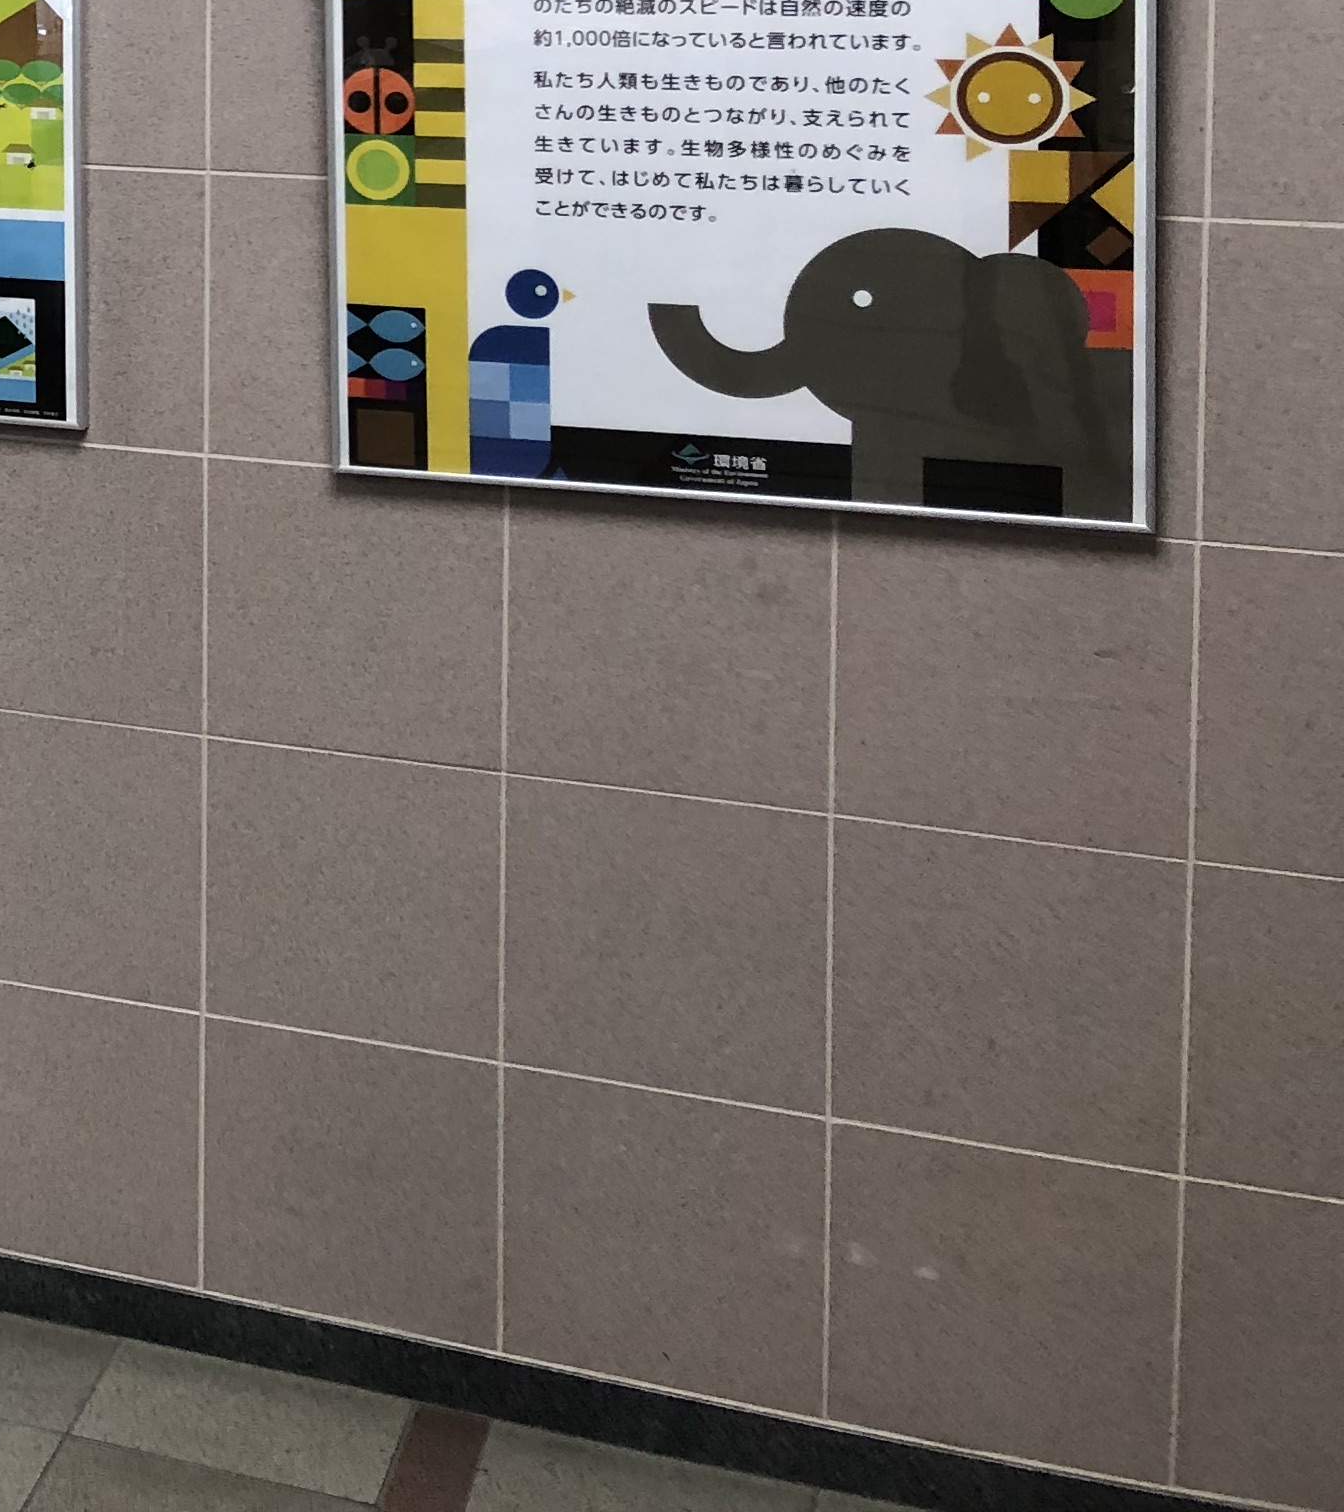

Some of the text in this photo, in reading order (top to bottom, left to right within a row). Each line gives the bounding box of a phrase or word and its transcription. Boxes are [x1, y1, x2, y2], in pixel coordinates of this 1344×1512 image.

[533, 29, 921, 52] 約1,000倍になっていると言われています。
[533, 71, 911, 95] 私たち人類も生きものであり、他のたく
[534, 103, 910, 129] さんの生きものとつながり、支えられて
[534, 136, 911, 163] 生きています。生物多様性のめぐみを
[534, 167, 911, 196] 受けて、はじめて私たちは暮らしていく
[535, 200, 717, 223] ことができるのです。
